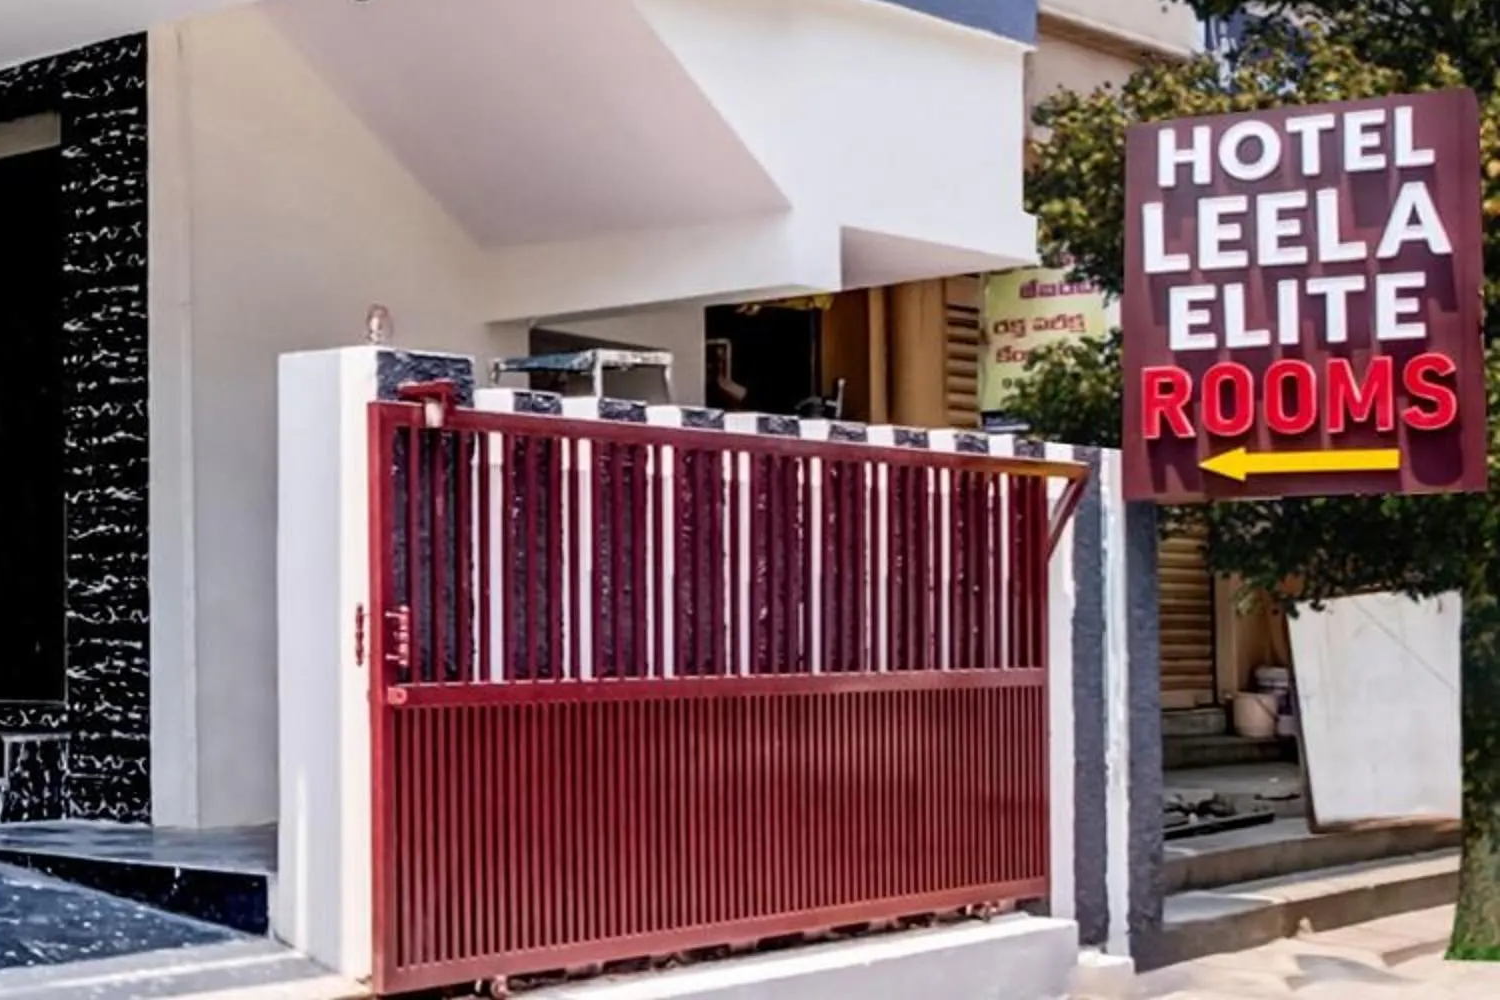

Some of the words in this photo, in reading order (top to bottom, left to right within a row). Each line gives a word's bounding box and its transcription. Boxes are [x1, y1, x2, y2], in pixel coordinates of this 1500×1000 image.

[1157, 106, 1436, 188] HOTEL
[1142, 181, 1452, 275] LEELA
[1169, 271, 1427, 351] ELITE
[1140, 353, 1458, 441] ROOMS
